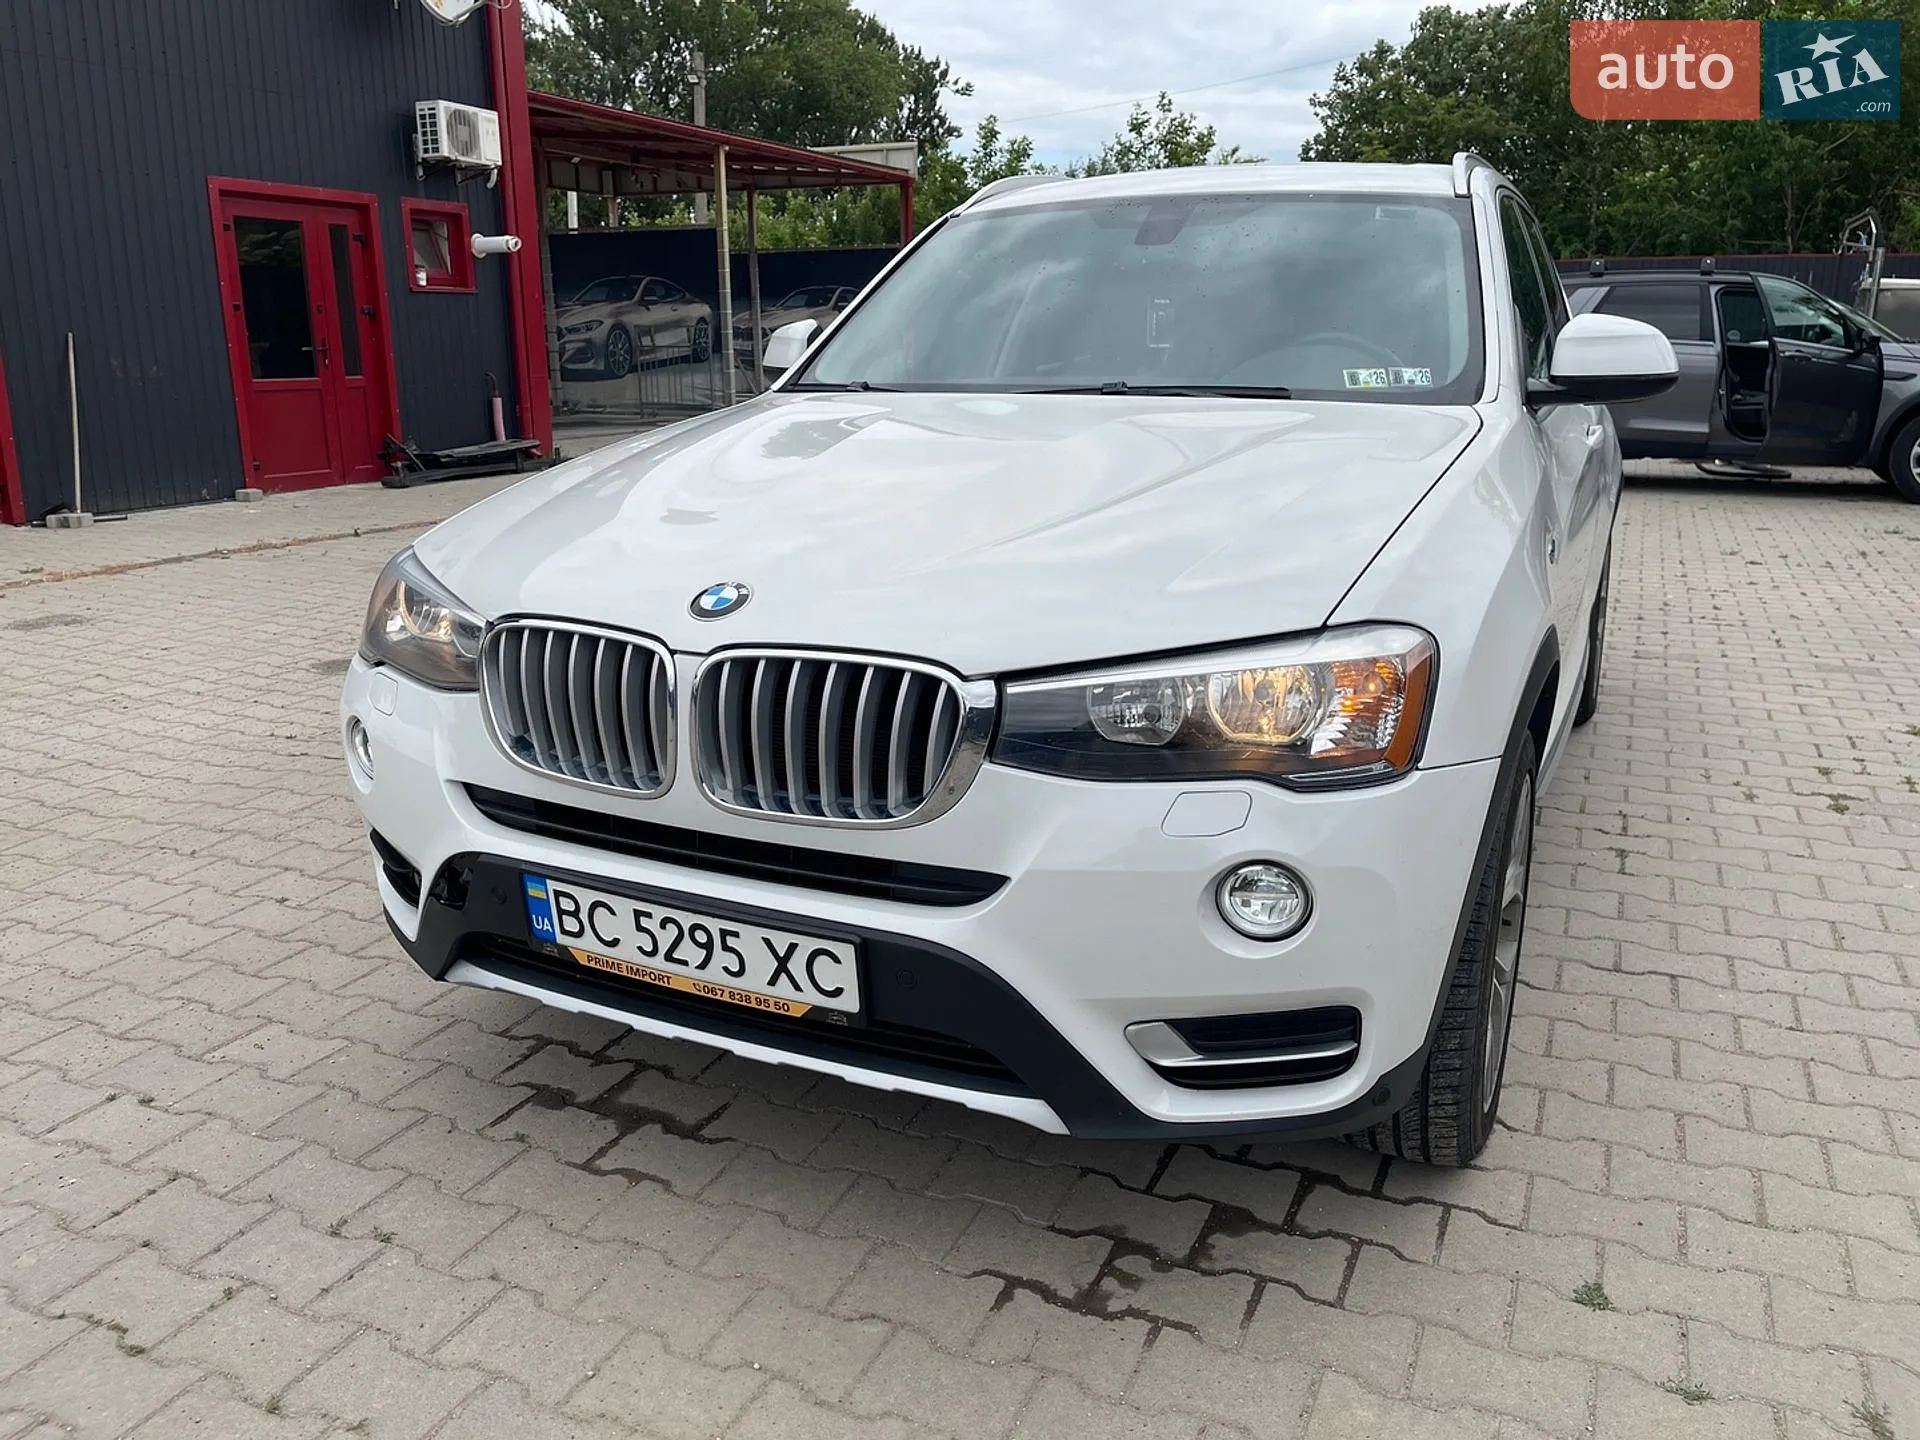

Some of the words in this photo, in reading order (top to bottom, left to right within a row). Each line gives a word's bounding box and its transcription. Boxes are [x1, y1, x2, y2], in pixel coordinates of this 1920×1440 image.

[532, 914, 554, 933] UA
[552, 889, 622, 948] BC
[633, 908, 747, 979] 5295
[761, 935, 845, 999] XC
[586, 954, 624, 974] PRIME
[625, 965, 673, 986] IMPORT
[702, 984, 725, 999] 067
[728, 990, 753, 1005] 838
[754, 997, 771, 1009] 95
[774, 1001, 791, 1013] 50
